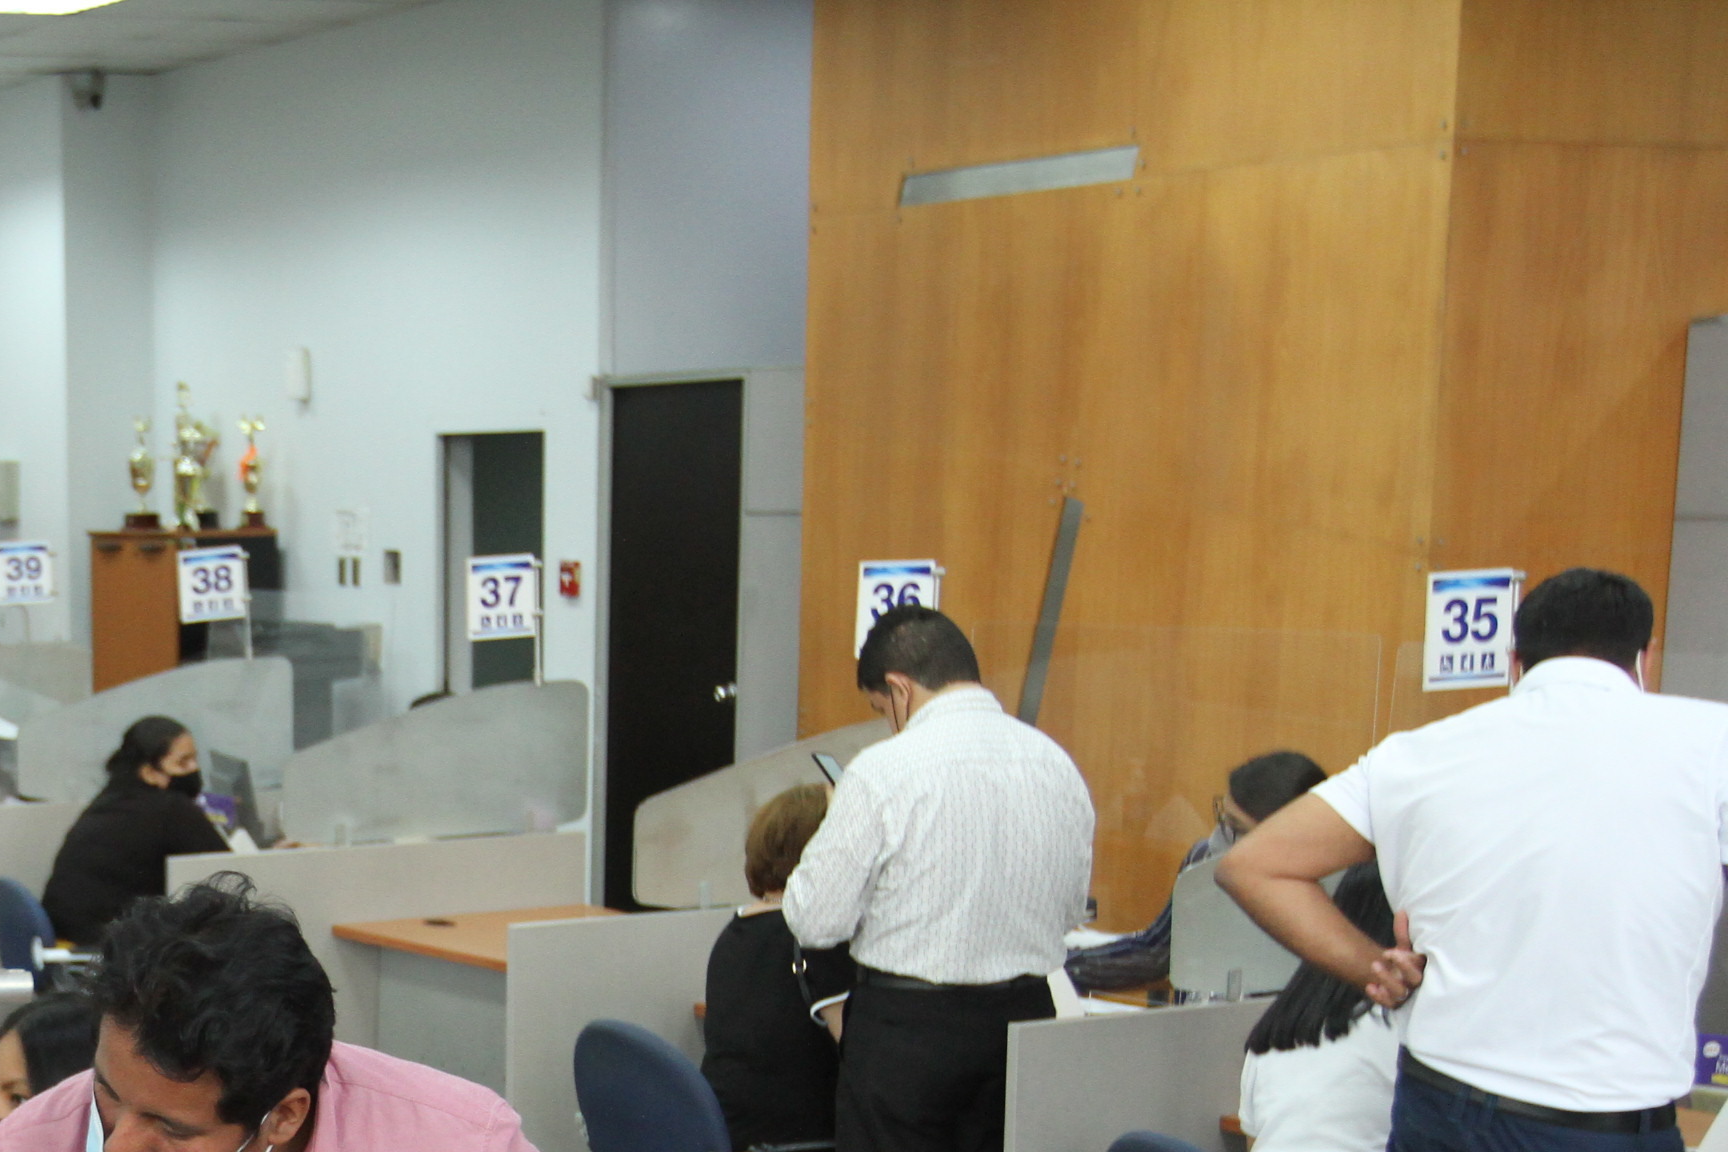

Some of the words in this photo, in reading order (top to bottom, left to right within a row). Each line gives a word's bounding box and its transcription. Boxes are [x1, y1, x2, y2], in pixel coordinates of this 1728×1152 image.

[6, 556, 42, 581] 39
[192, 565, 232, 594] 38
[480, 576, 522, 608] 37
[871, 582, 921, 618] 36
[1441, 597, 1498, 643] 35
